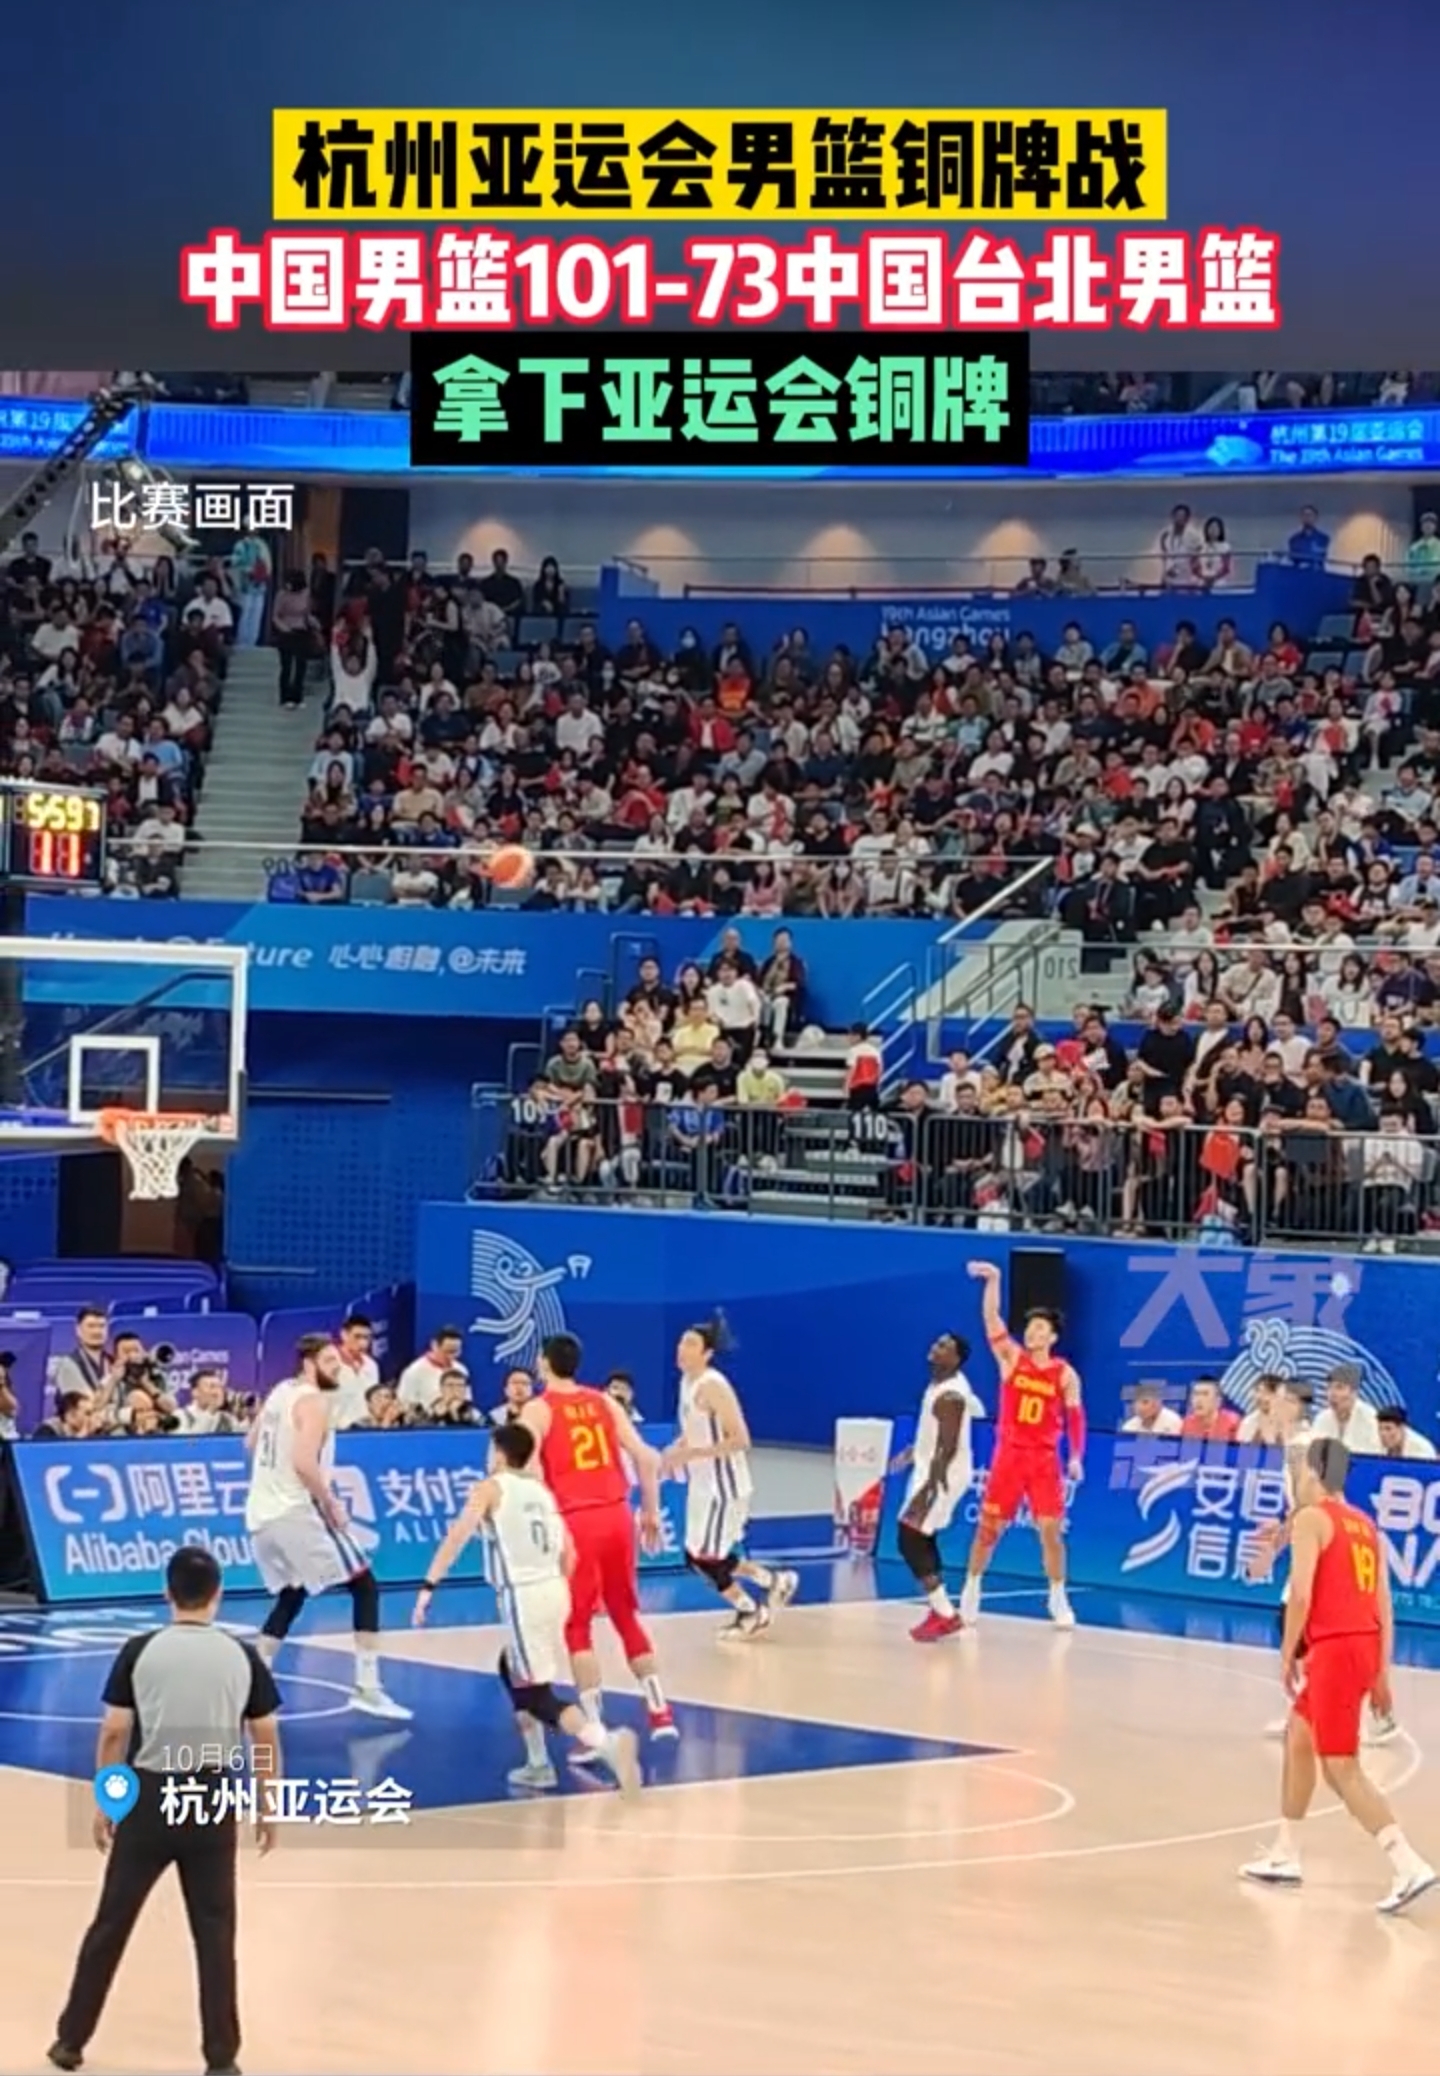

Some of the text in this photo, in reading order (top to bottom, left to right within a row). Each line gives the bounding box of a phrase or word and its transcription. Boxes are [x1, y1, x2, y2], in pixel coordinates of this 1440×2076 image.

[916, 605, 957, 621] Asian
[960, 604, 1010, 621] Games
[852, 1112, 887, 1139] 110
[1018, 1395, 1045, 1424] 10
[570, 1423, 609, 1470] 21
[128, 1463, 250, 1518] 阿里云
[65, 1531, 177, 1574] Alibaba
